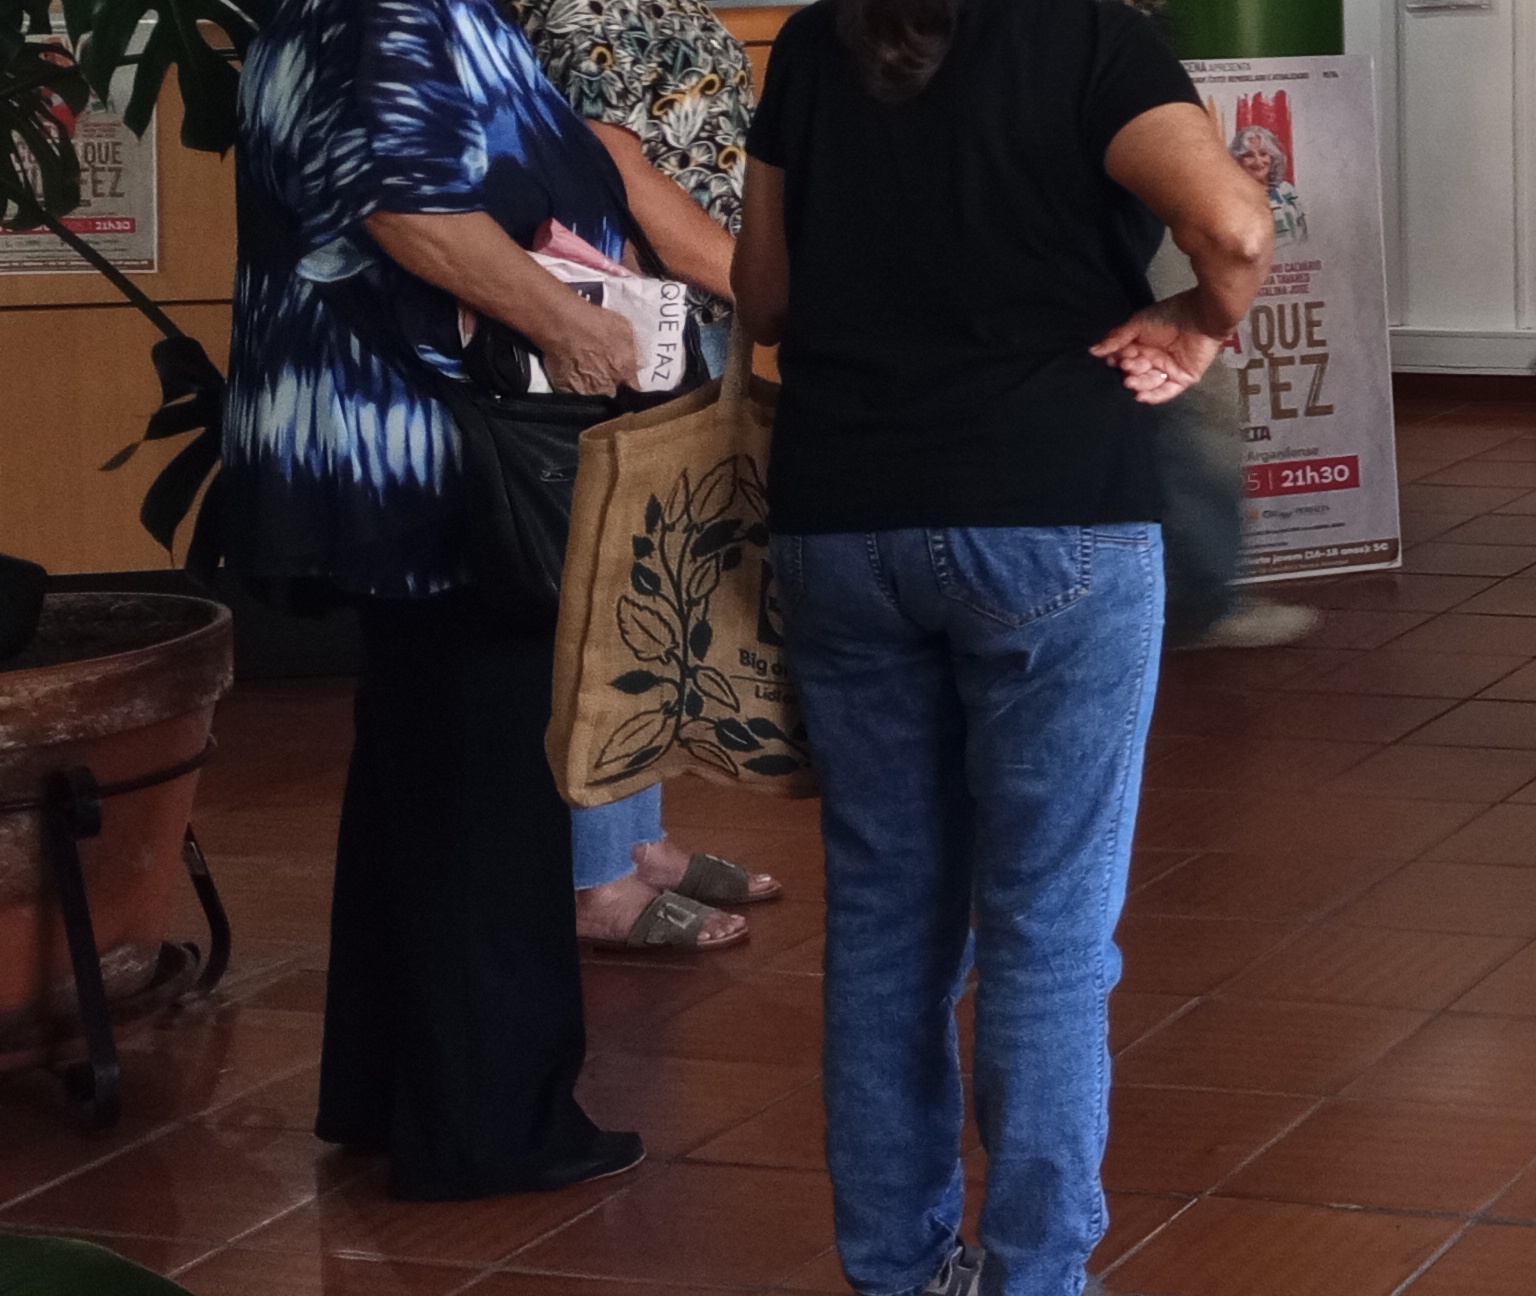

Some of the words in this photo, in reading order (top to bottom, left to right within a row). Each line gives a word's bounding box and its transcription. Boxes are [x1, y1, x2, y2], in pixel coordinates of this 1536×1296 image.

[84, 141, 123, 168] QUE
[658, 282, 681, 332] QUE
[1251, 301, 1327, 359] QUE
[651, 343, 677, 383] FAZ
[1238, 353, 1334, 422] FEZ
[1280, 464, 1350, 488] 21h30
